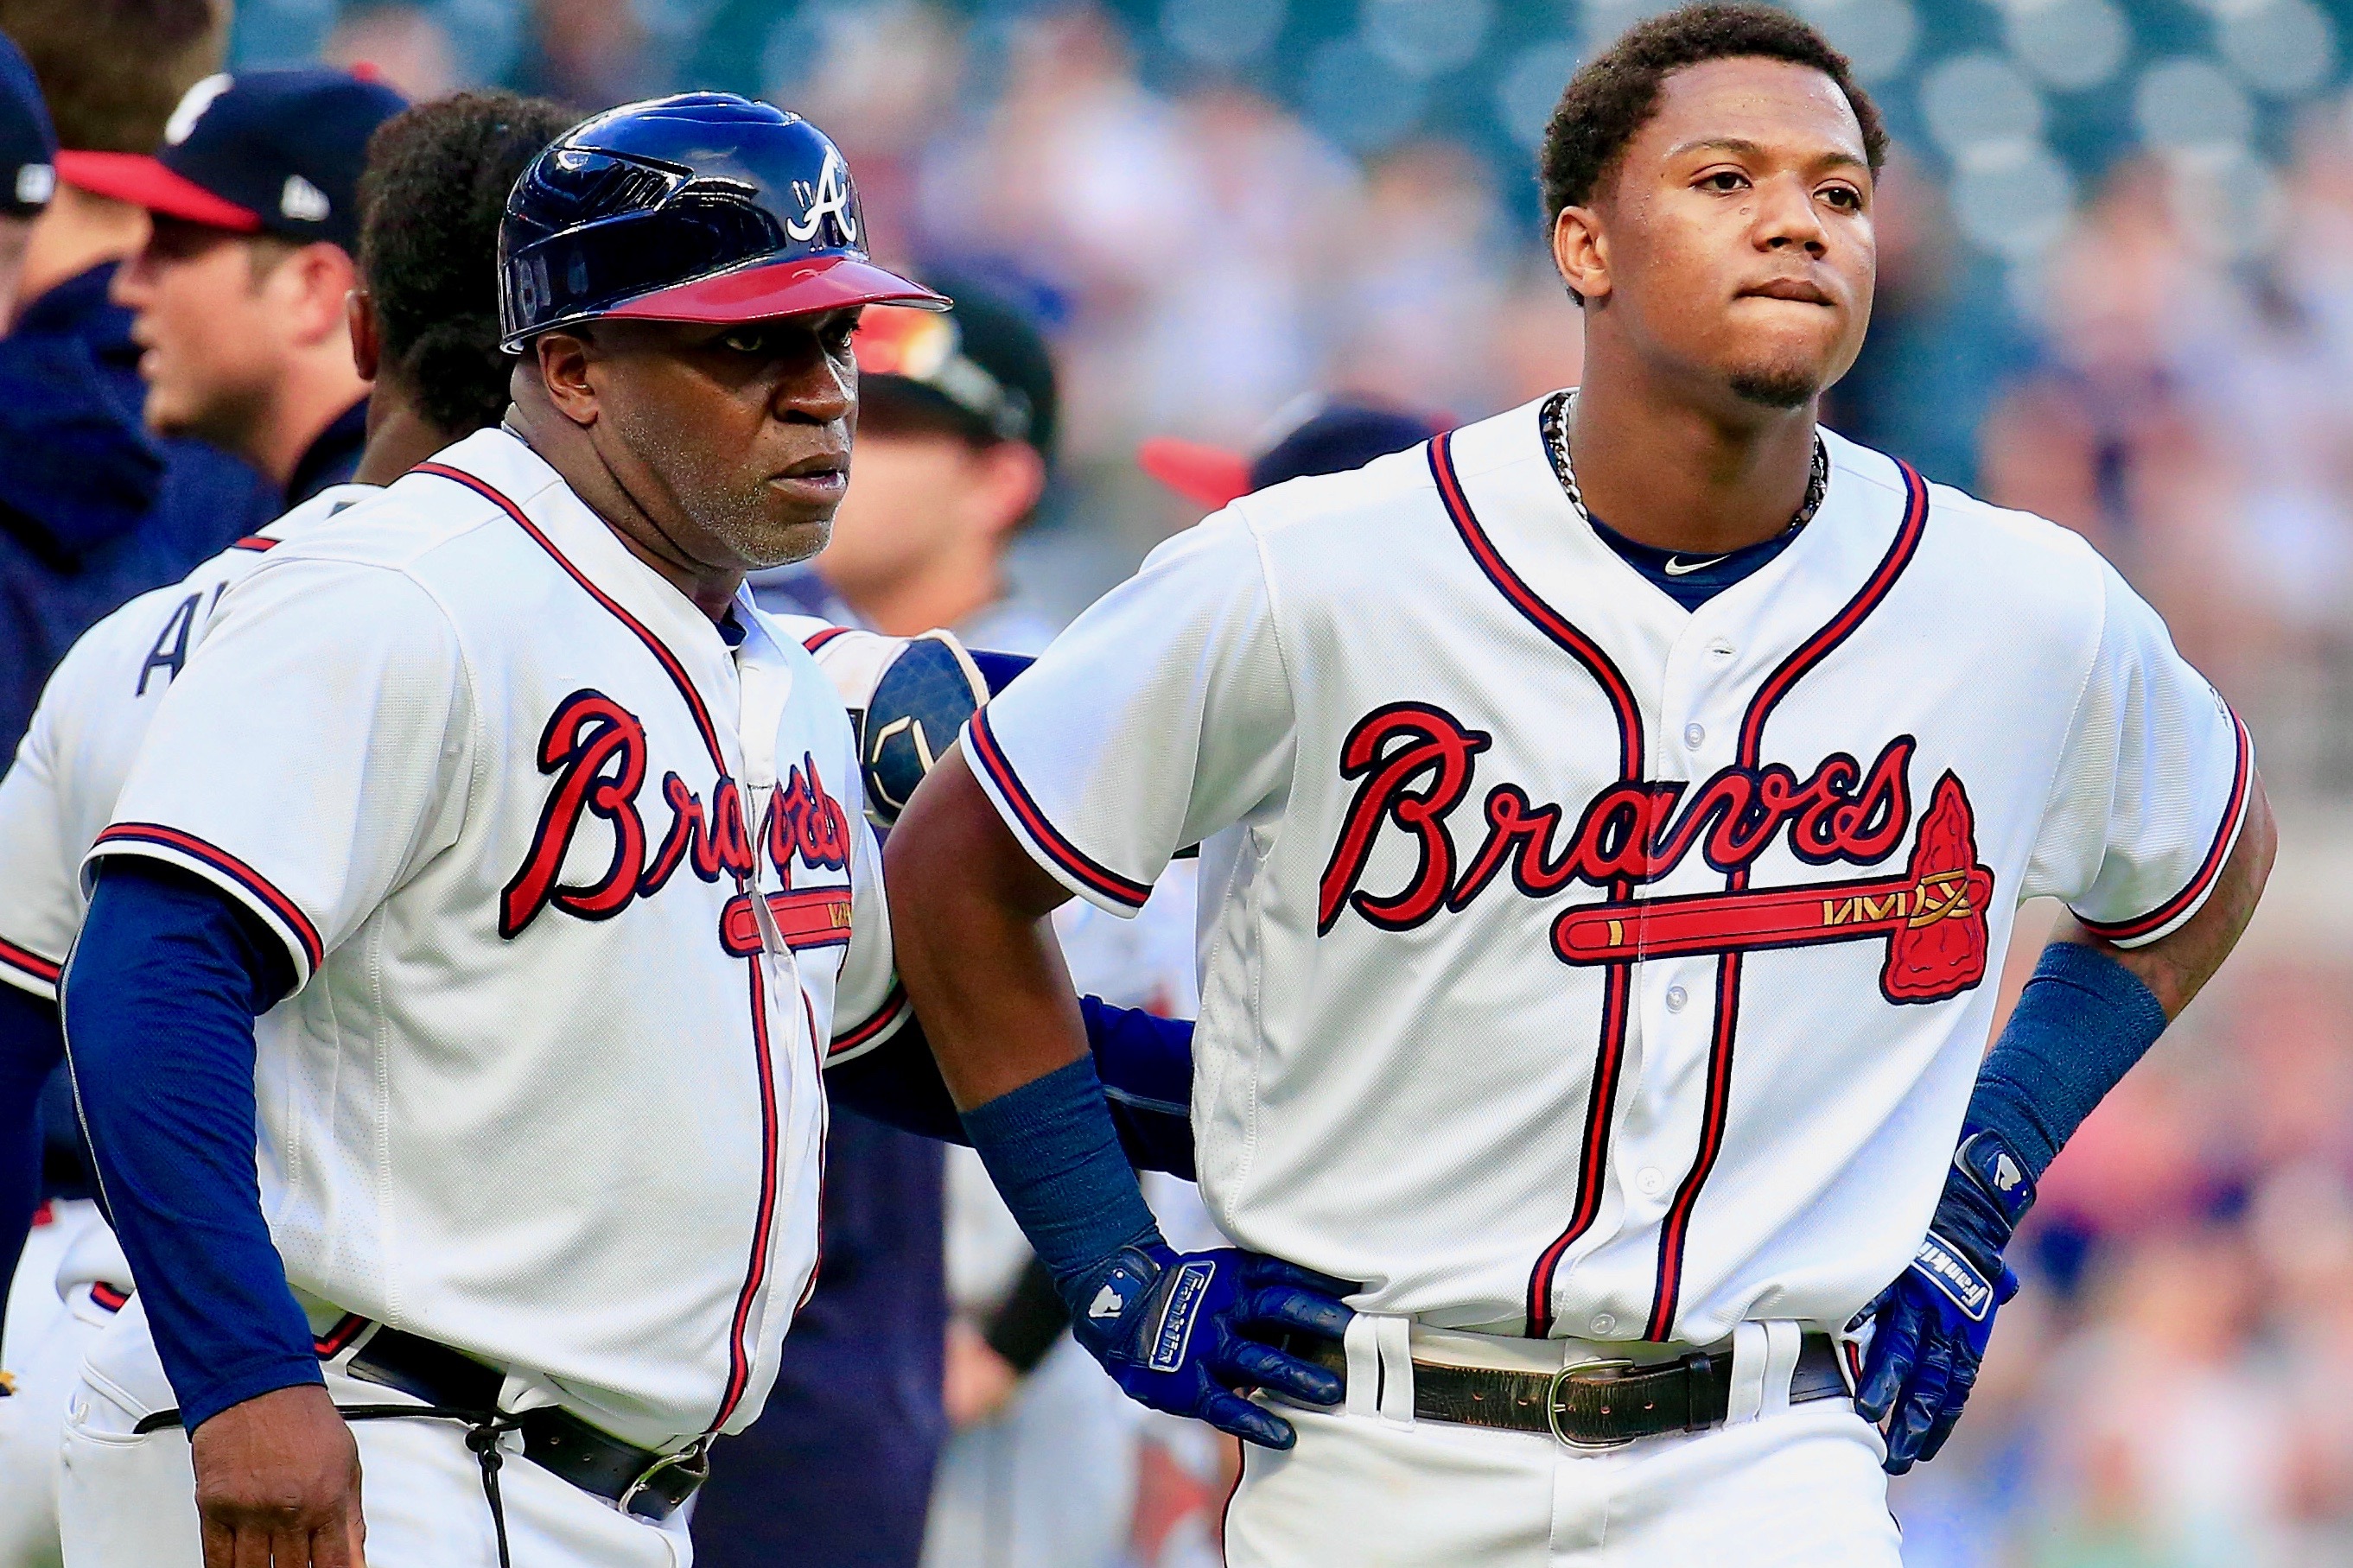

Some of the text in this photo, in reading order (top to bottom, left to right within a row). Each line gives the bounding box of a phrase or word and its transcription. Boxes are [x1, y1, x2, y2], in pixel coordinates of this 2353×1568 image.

[499, 689, 852, 940] Braves
[1317, 701, 1917, 938] Braves
[1917, 1241, 1988, 1307] Frankli
